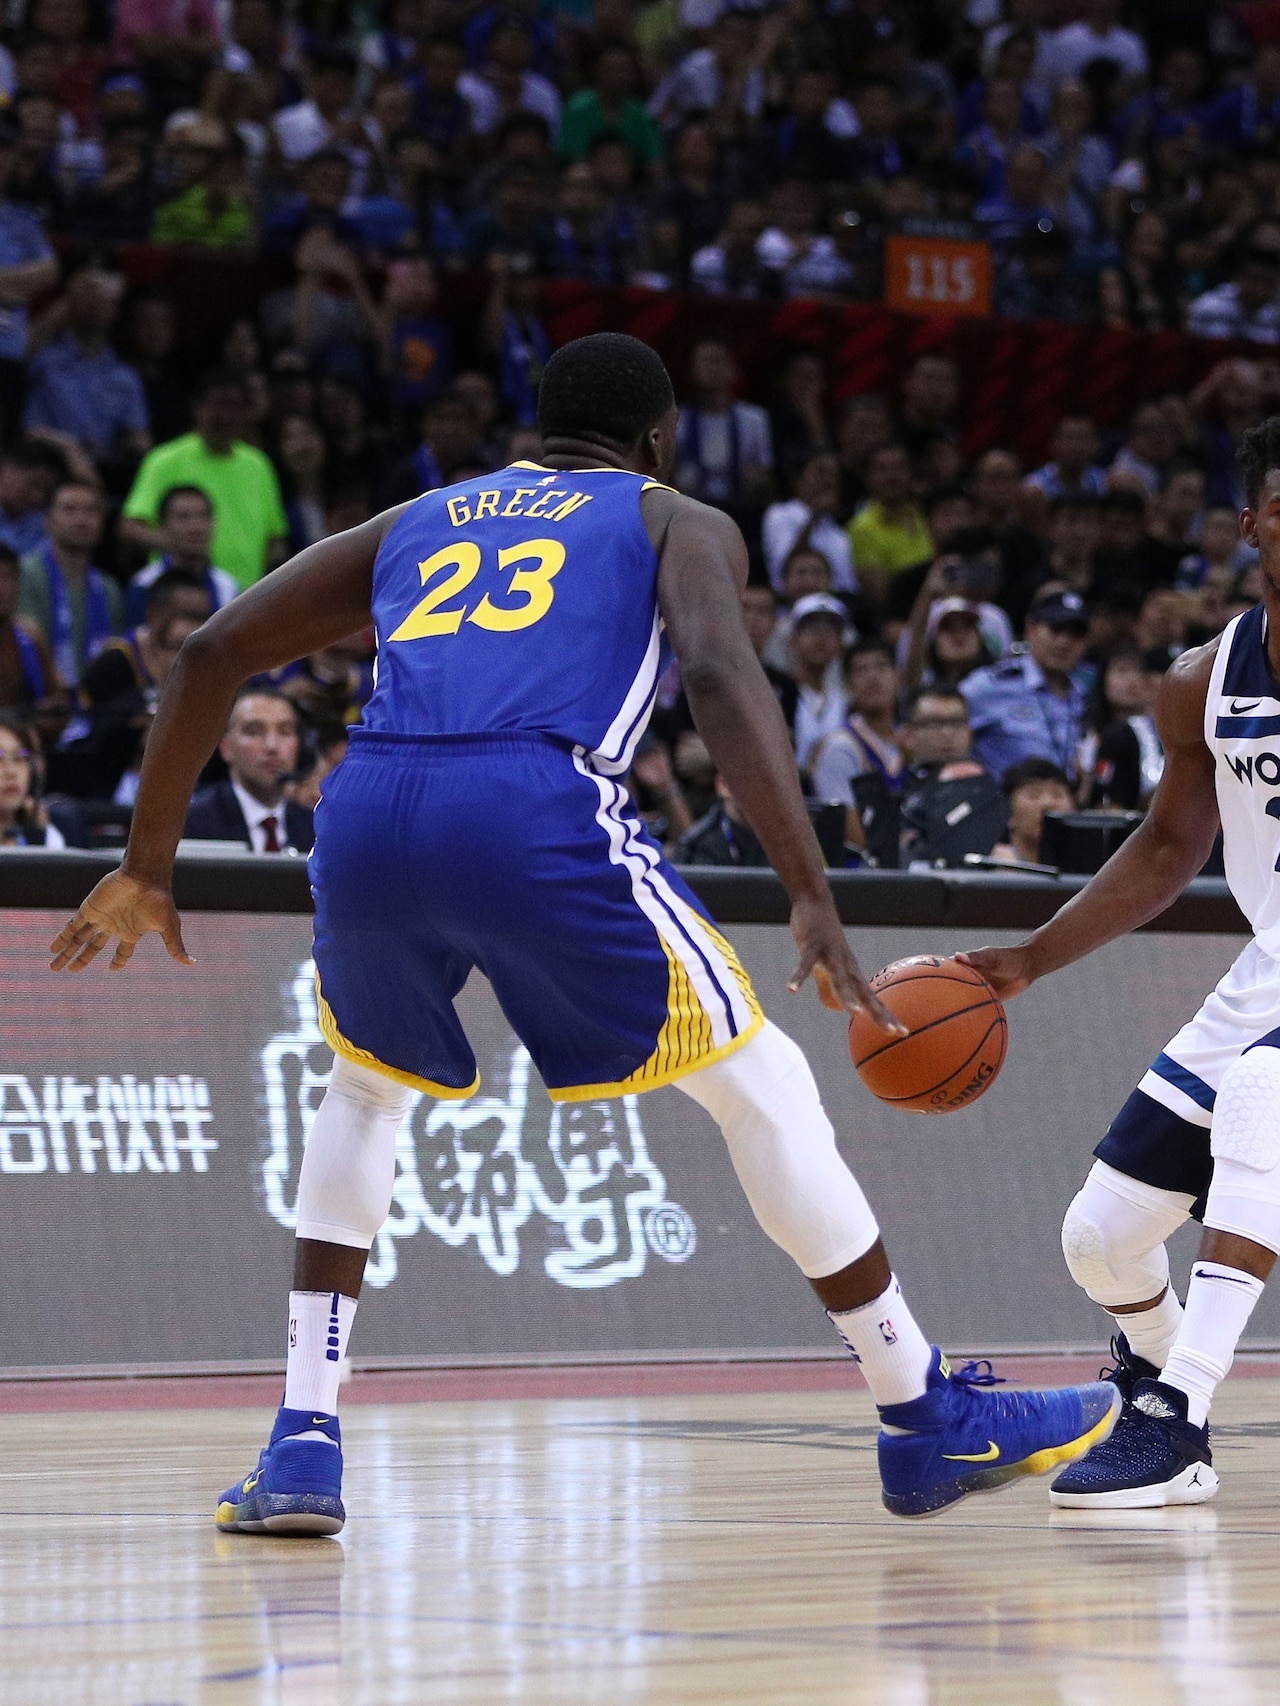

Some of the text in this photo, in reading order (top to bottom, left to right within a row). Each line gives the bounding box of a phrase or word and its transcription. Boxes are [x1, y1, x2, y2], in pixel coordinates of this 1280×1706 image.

[906, 255, 975, 303] 115
[446, 488, 593, 527] GREEN
[386, 538, 567, 642] 23
[944, 1062, 994, 1107] DING
[0, 1074, 220, 1174] 合作伙伴
